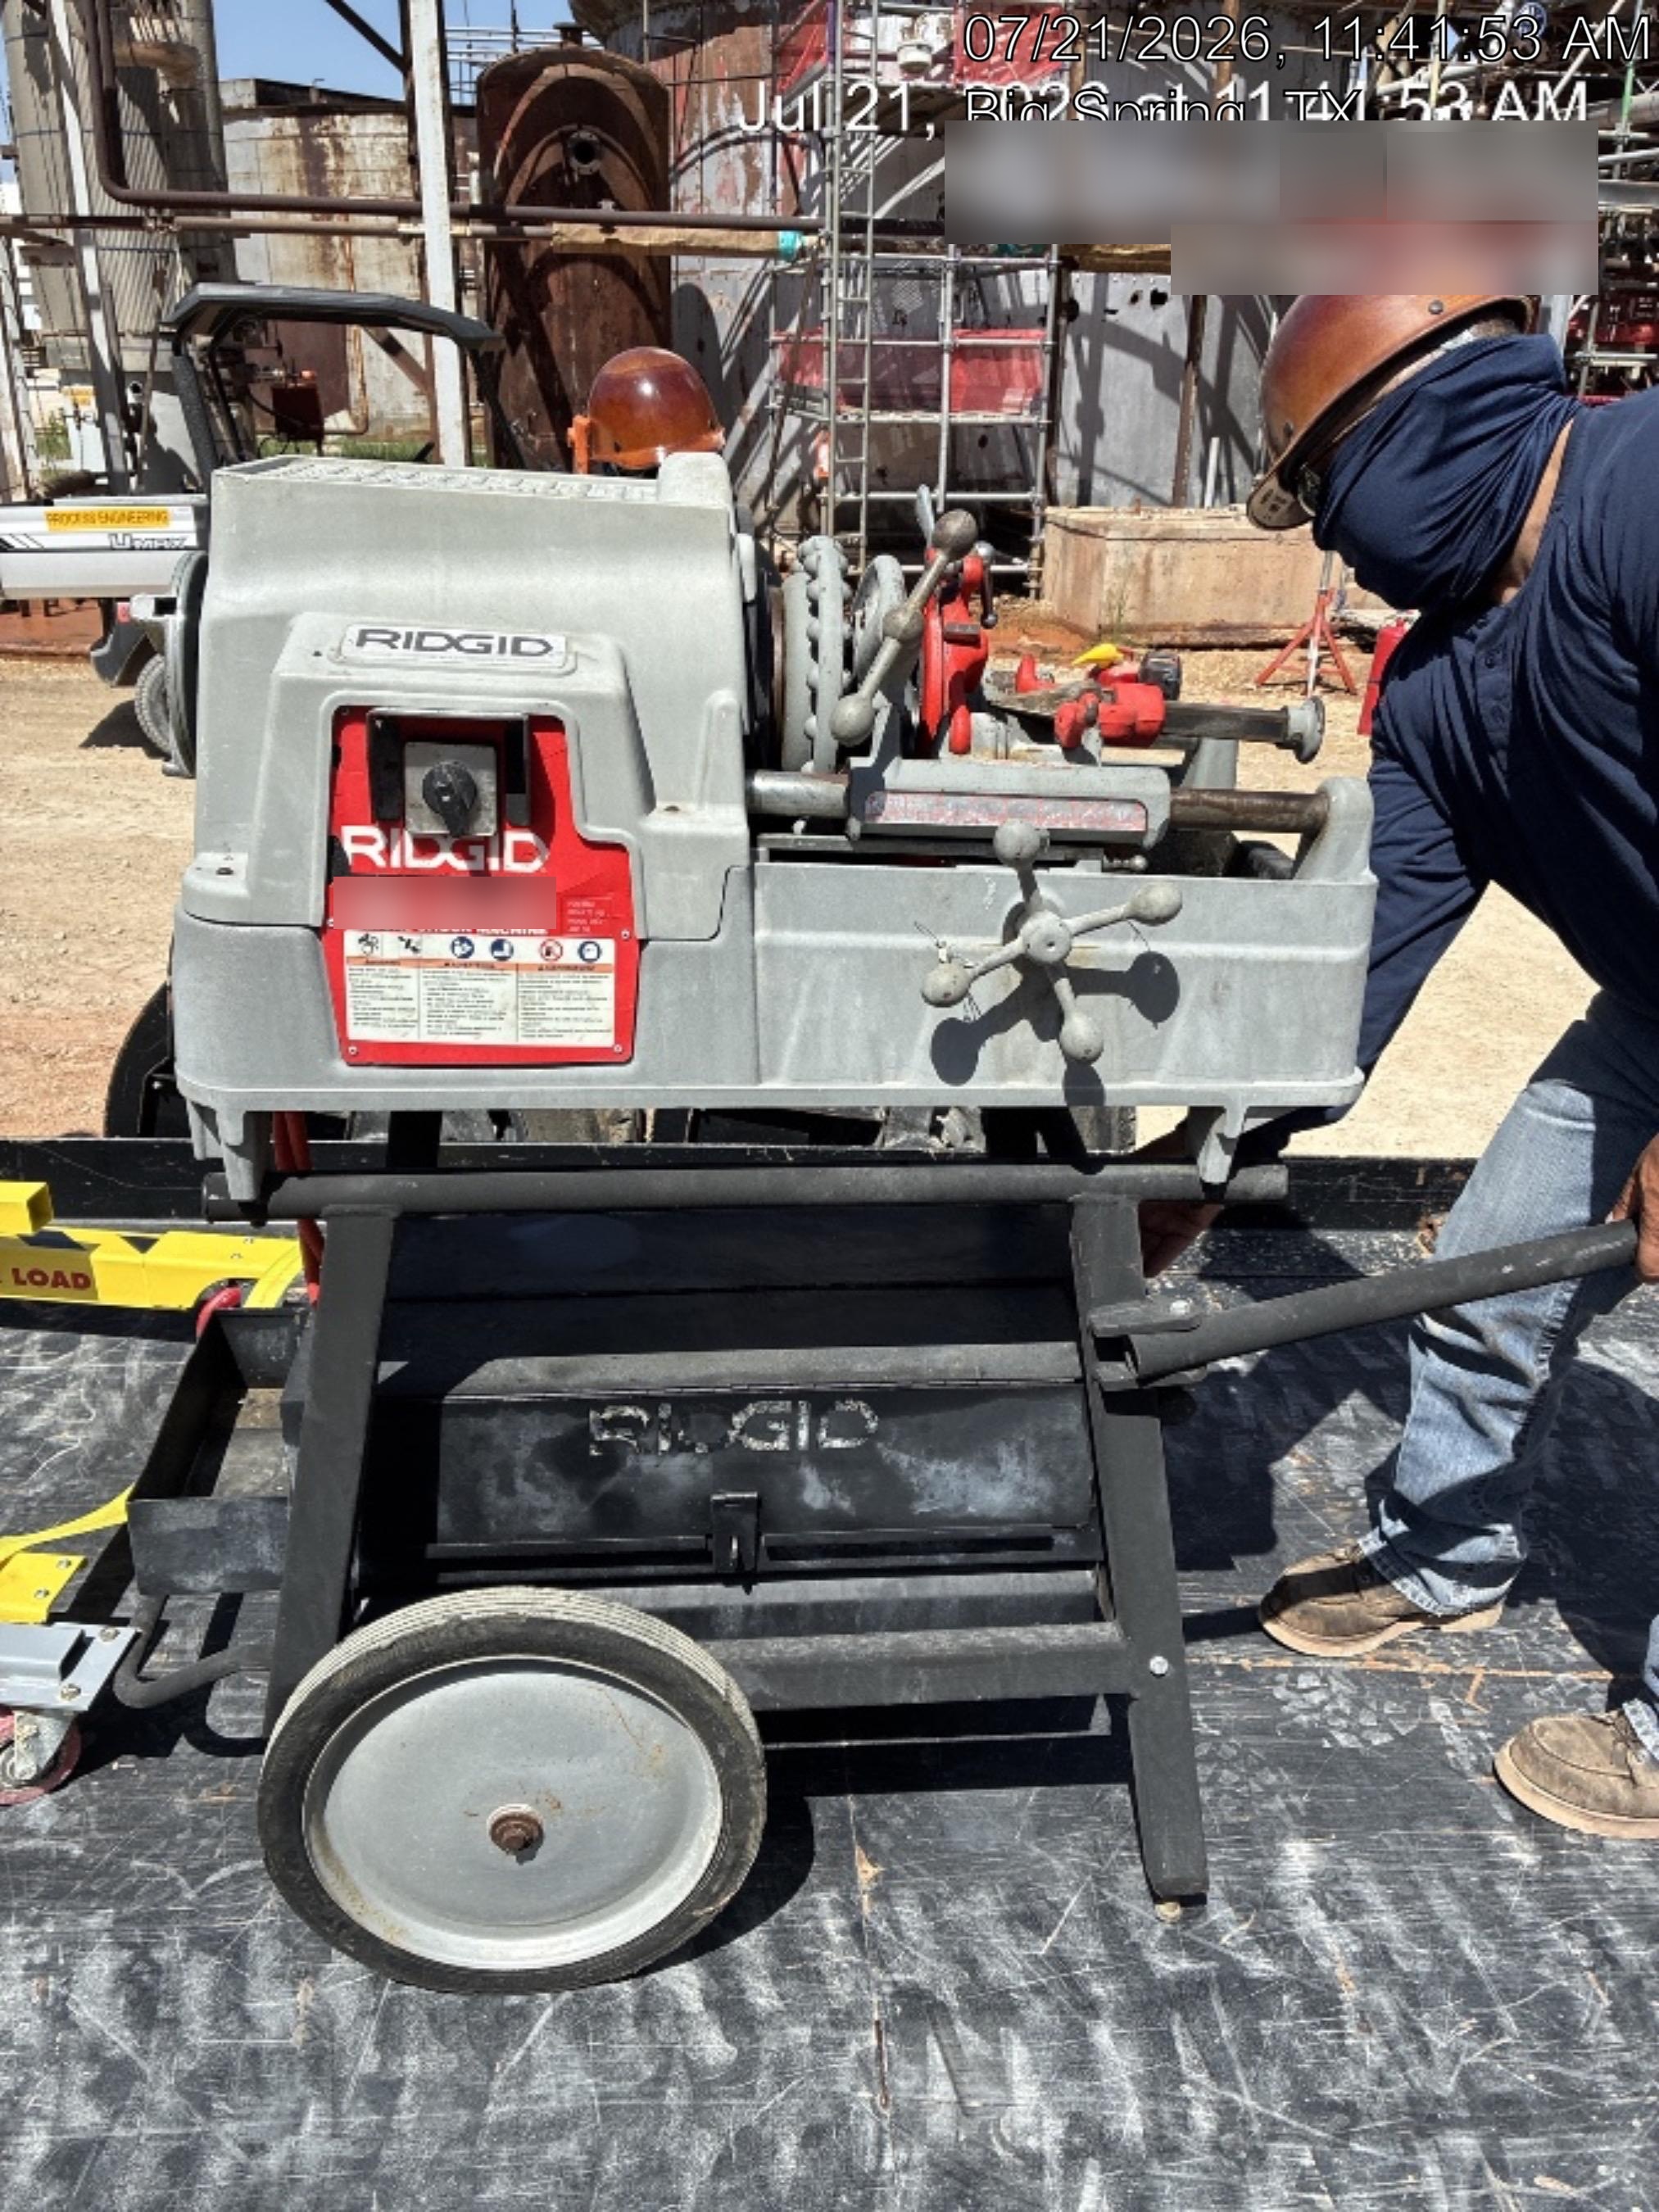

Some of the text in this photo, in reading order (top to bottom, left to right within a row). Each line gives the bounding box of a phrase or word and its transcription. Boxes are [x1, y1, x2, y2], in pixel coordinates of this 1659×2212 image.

[46, 510, 169, 526] PROCESS ENGINEERING
[356, 628, 554, 656] RIDGID
[341, 825, 549, 873] RIDGID
[11, 1267, 91, 1290] LOAD
